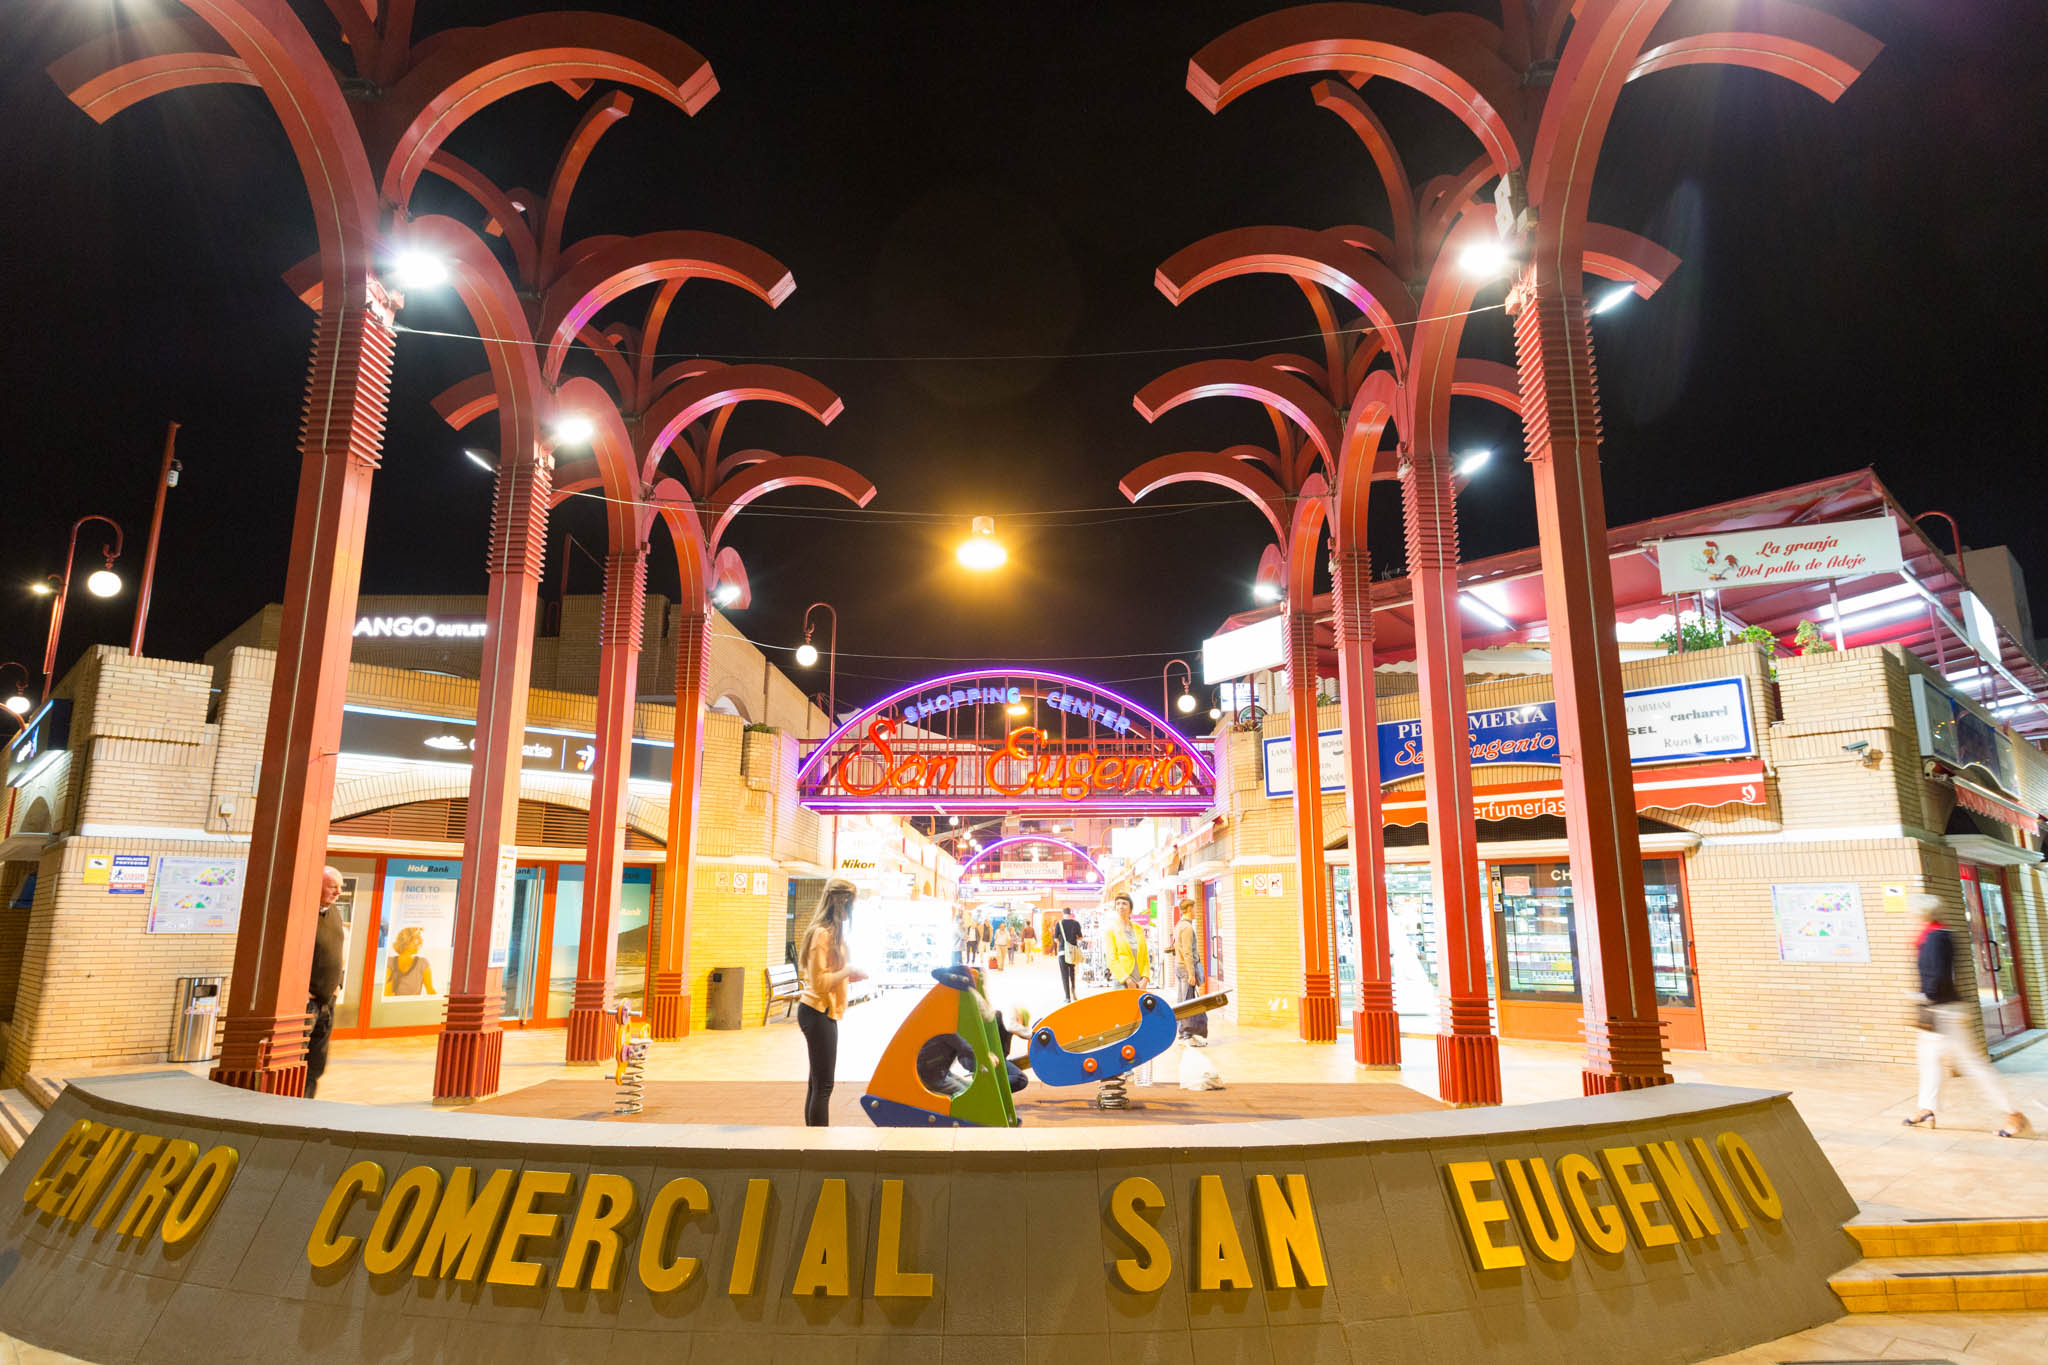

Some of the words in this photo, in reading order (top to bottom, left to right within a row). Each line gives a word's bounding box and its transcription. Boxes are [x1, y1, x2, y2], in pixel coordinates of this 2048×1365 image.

[1756, 541, 1781, 557] La
[1783, 535, 1840, 556] granja
[1736, 563, 1764, 578] Del
[1764, 560, 1801, 578] pollo
[1805, 558, 1823, 570] de
[1826, 553, 1867, 569] Adeje
[352, 616, 435, 637] ANGO
[436, 623, 487, 637] OUTLET
[903, 686, 1020, 723] SHOPPING
[1046, 690, 1131, 735] CENTER
[1670, 706, 1728, 721] cacharel
[1627, 726, 1657, 735] SEL
[838, 719, 958, 796] San
[985, 726, 1194, 802] Eugenio
[1395, 740, 1425, 766] Sa
[1473, 798, 1566, 819] erfumerías
[408, 863, 449, 873] HolaBank
[841, 859, 875, 869] Nikon
[1550, 869, 1572, 881] CH
[406, 885, 425, 893] NICE
[429, 885, 441, 893] TO
[24, 1119, 239, 1243] CENTRO
[306, 1160, 935, 1298] COMERCIAL
[1111, 1174, 1328, 1293] SAN
[1446, 1130, 1784, 1271] EUGENIO
